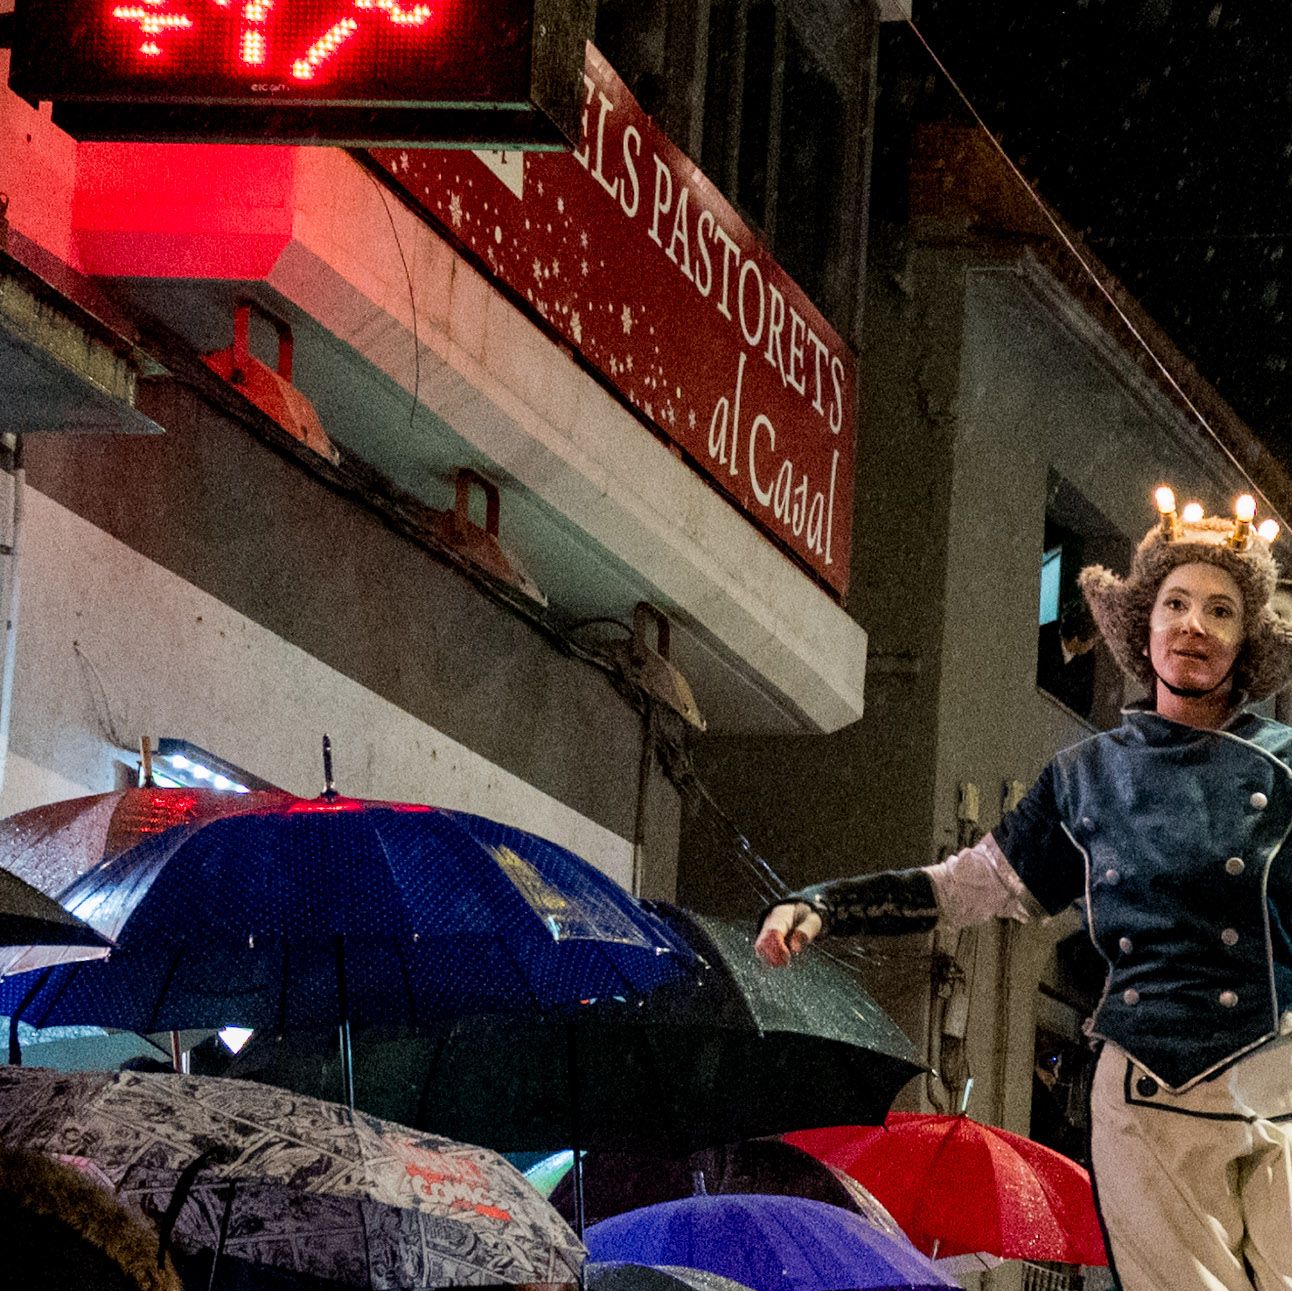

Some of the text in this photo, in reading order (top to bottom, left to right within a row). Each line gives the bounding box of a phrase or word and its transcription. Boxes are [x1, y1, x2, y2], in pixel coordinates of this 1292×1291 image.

[647, 152, 846, 435] PASTORETS
[708, 351, 841, 565] al Casal
